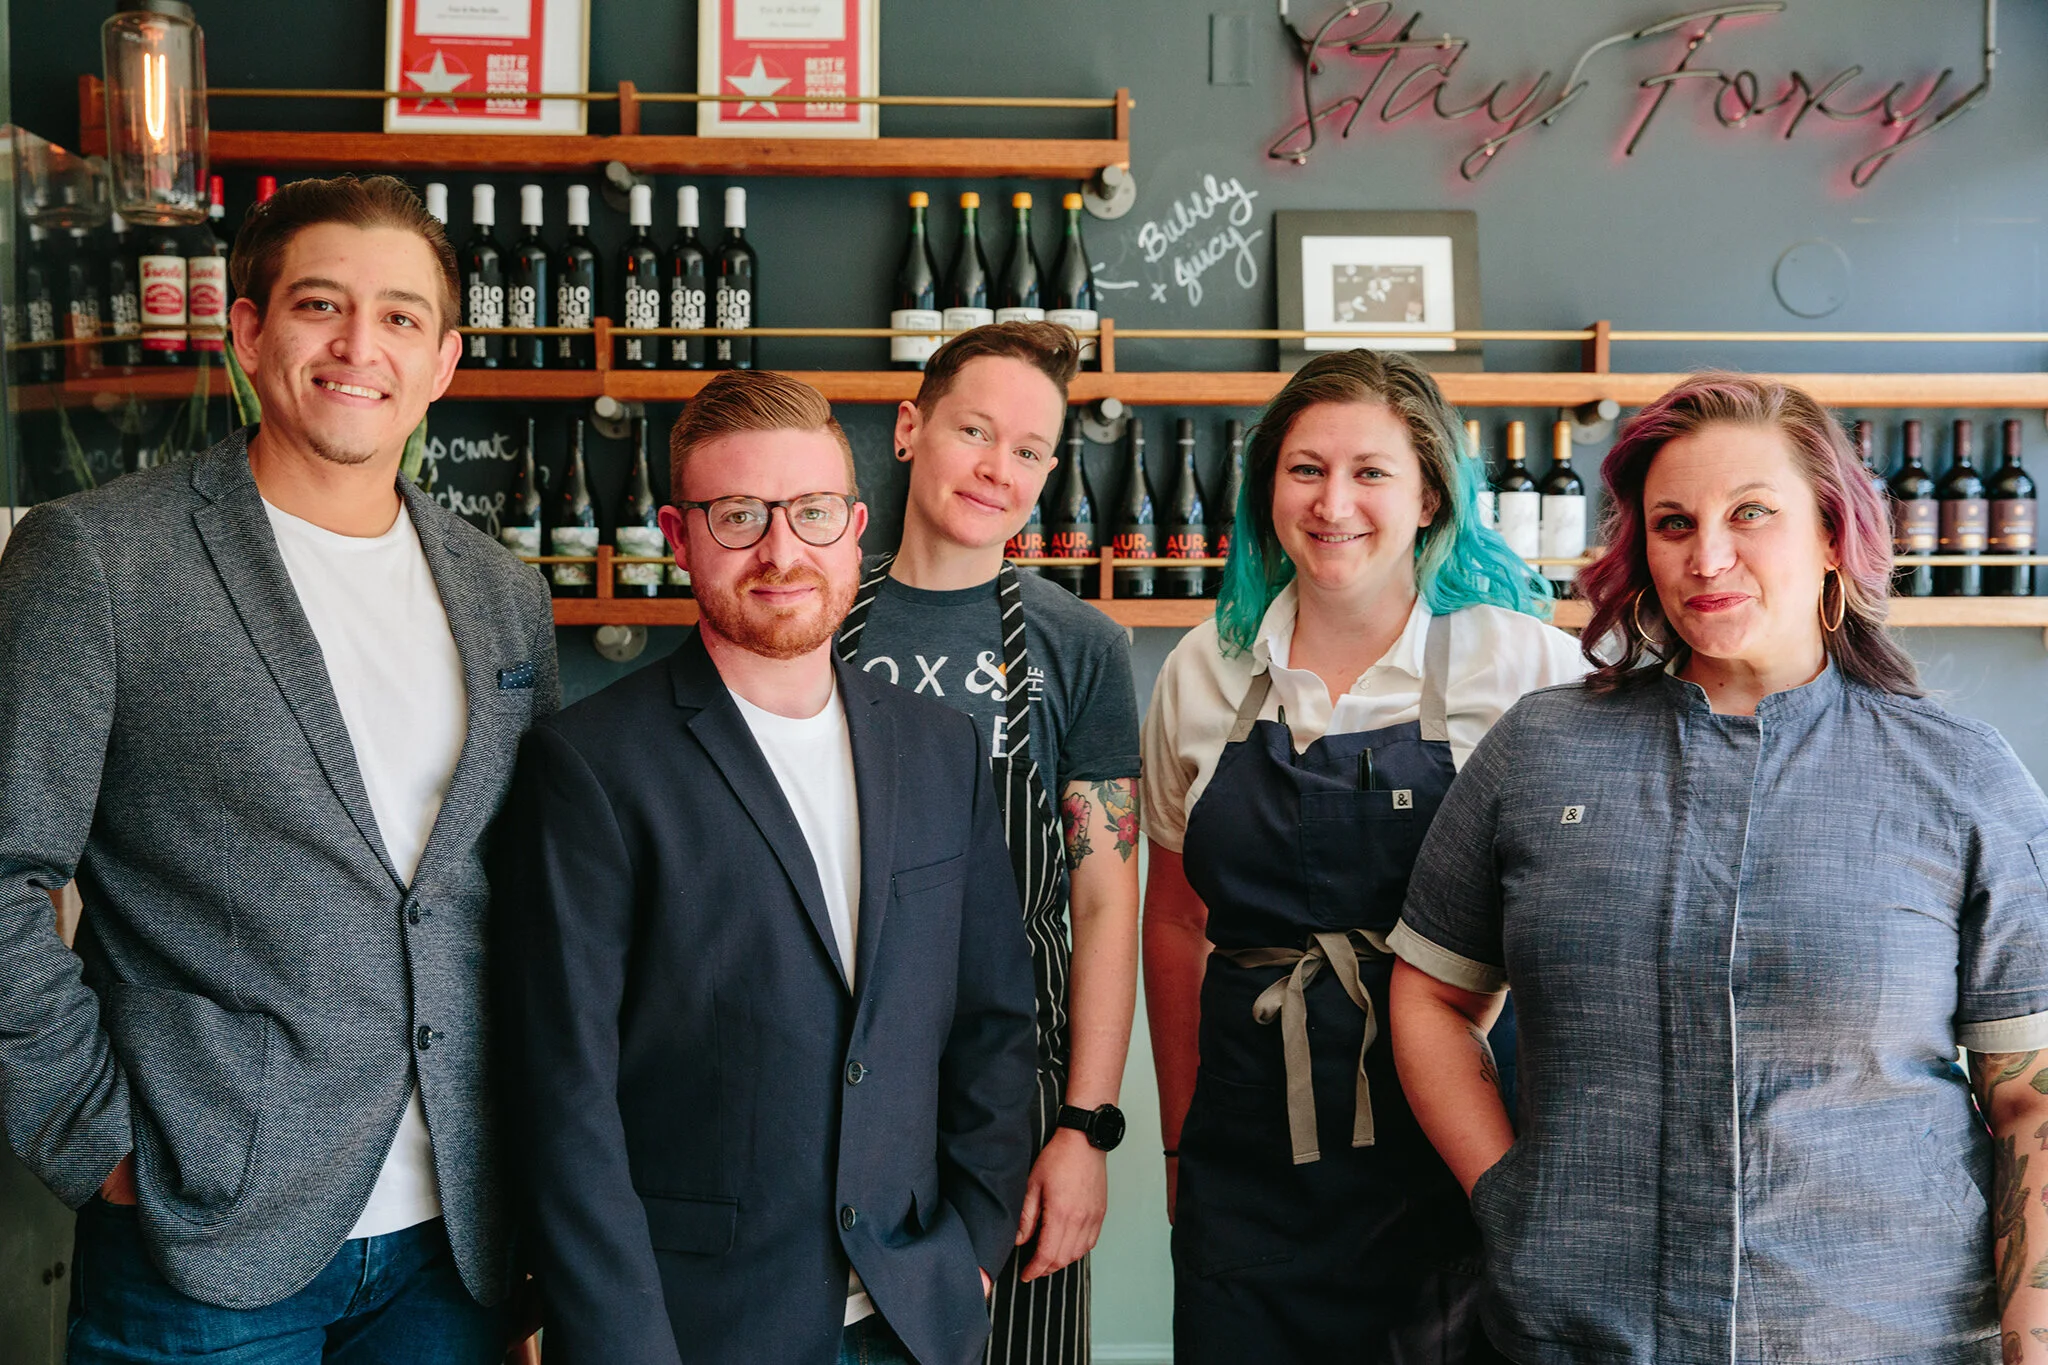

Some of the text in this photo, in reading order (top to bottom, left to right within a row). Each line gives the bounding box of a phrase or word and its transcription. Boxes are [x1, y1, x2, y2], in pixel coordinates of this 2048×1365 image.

[1269, 0, 1982, 188] Stay Foxy
[1138, 174, 1259, 263] Bubbly
[469, 285, 504, 302] GIO
[625, 288, 660, 306] GIO
[671, 289, 706, 306] GIO
[716, 288, 751, 306] GIO
[965, 650, 1008, 702] &
